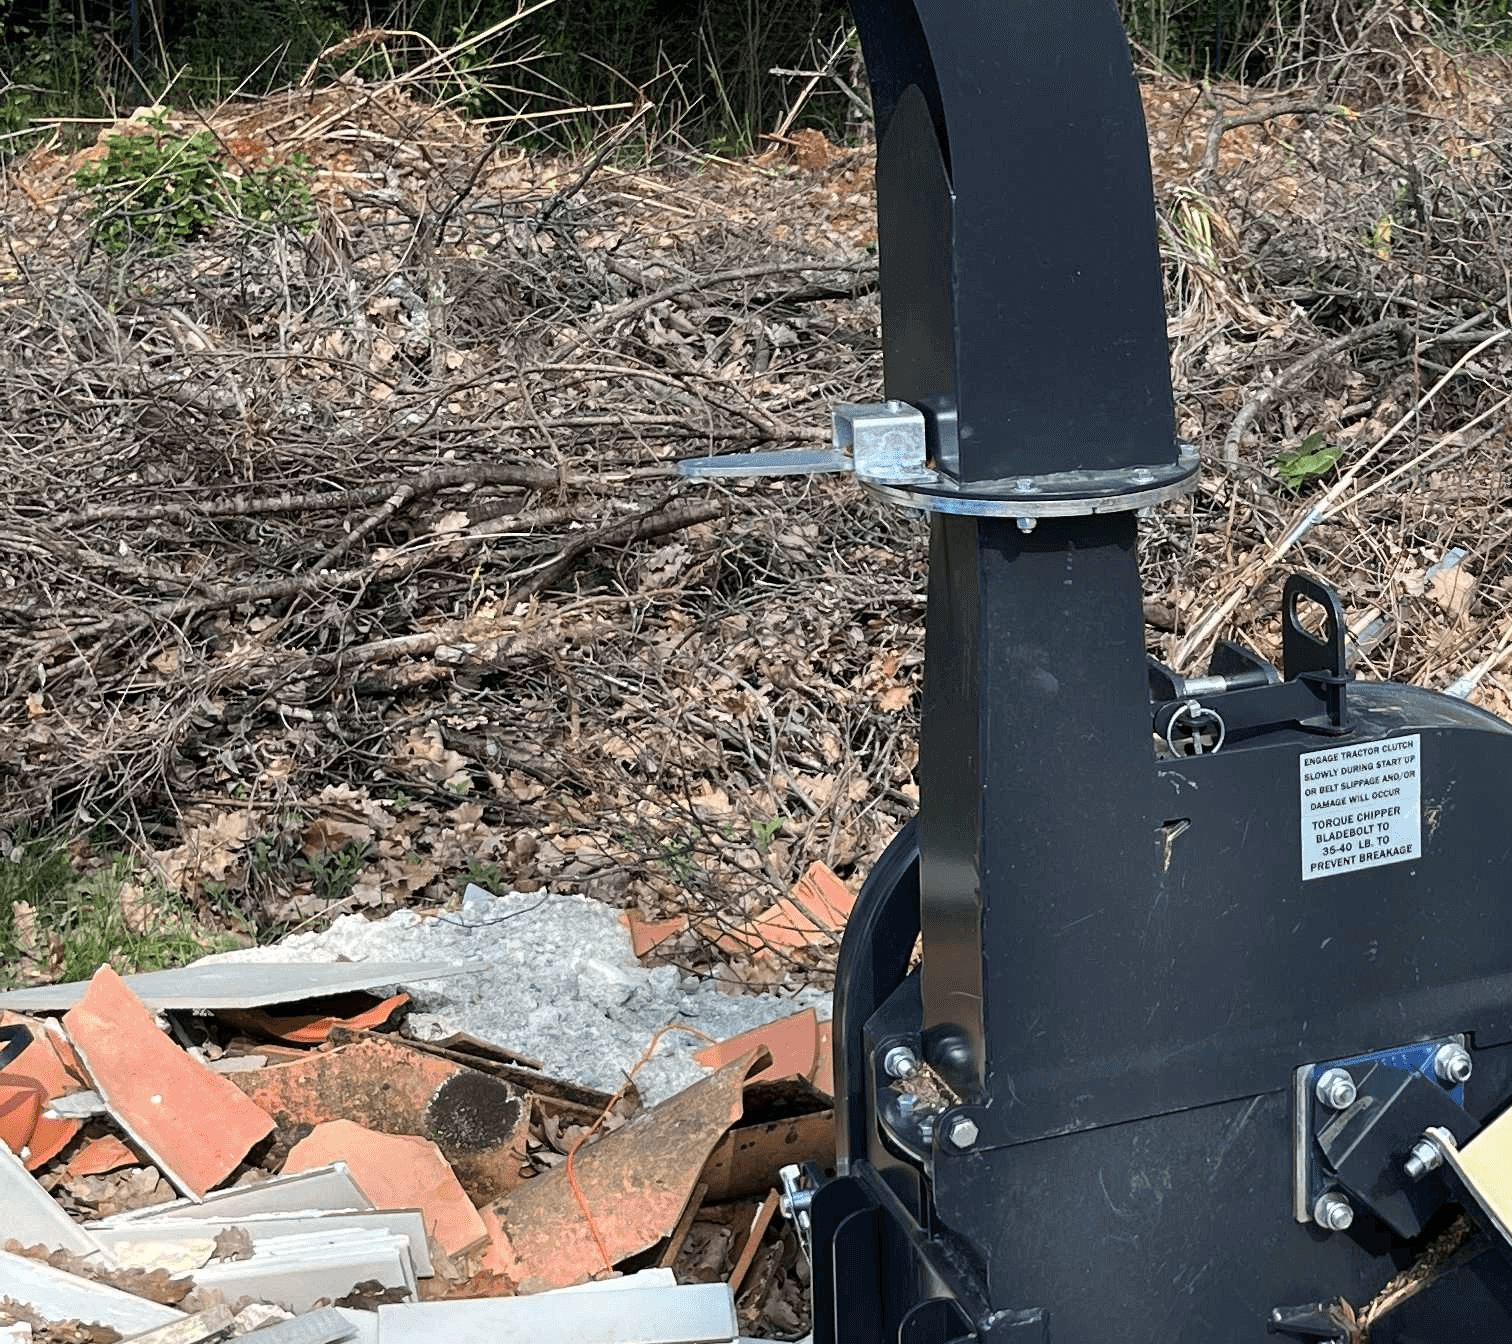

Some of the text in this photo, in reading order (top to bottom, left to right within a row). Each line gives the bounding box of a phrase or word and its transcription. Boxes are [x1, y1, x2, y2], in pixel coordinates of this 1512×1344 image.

[1304, 740, 1414, 766] ENGAGE TRACTOR CLUTCH
[1304, 755, 1415, 781] SLOWLY DURING START UP
[1305, 788, 1316, 796] OR
[1319, 783, 1339, 794] BELT
[1341, 776, 1379, 791] SLIPPAGE
[1310, 787, 1400, 811] DAMAGE WILL OCCUR
[1312, 807, 1401, 830] TORQUE CHIPPER
[1316, 822, 1390, 843] BLADEBOLT TO
[1377, 835, 1390, 845] TO
[1310, 844, 1413, 872] PREVENT BREAKAGE
